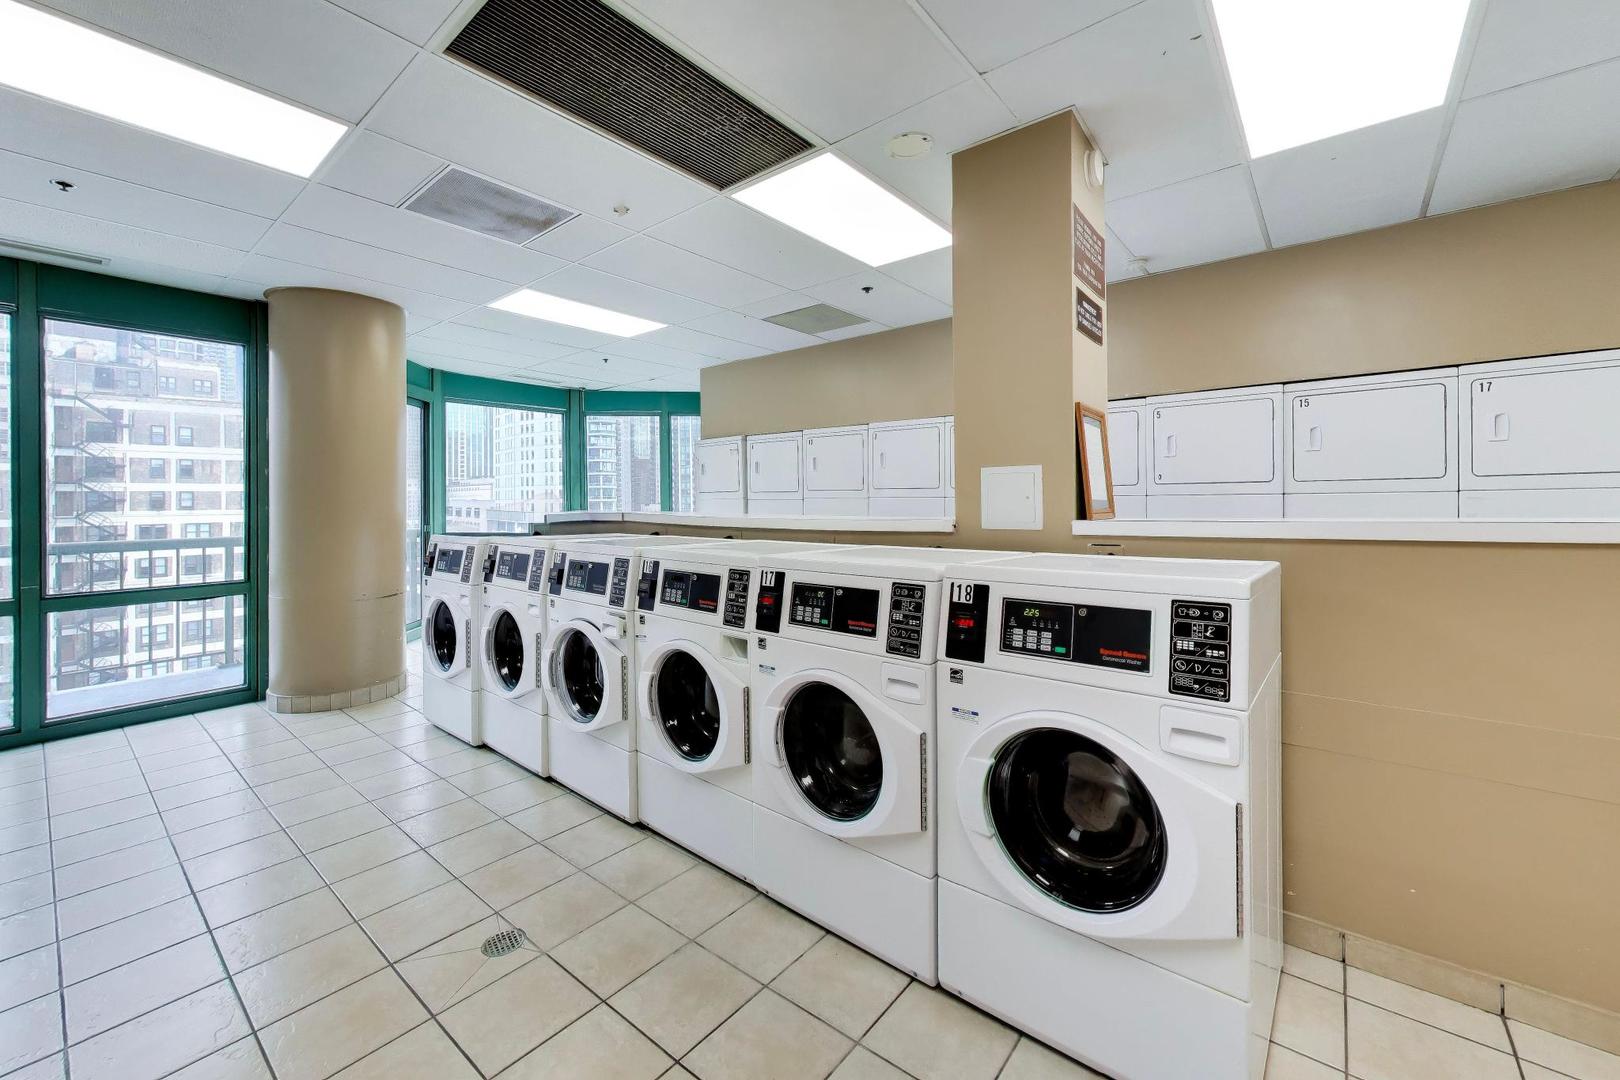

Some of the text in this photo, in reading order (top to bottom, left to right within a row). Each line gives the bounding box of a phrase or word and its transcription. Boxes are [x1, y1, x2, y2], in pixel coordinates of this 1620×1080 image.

[1479, 381, 1492, 393] 17
[1299, 398, 1310, 408] 15
[1156, 410, 1161, 419] 5
[763, 571, 775, 586] 17
[956, 583, 973, 602] 18
